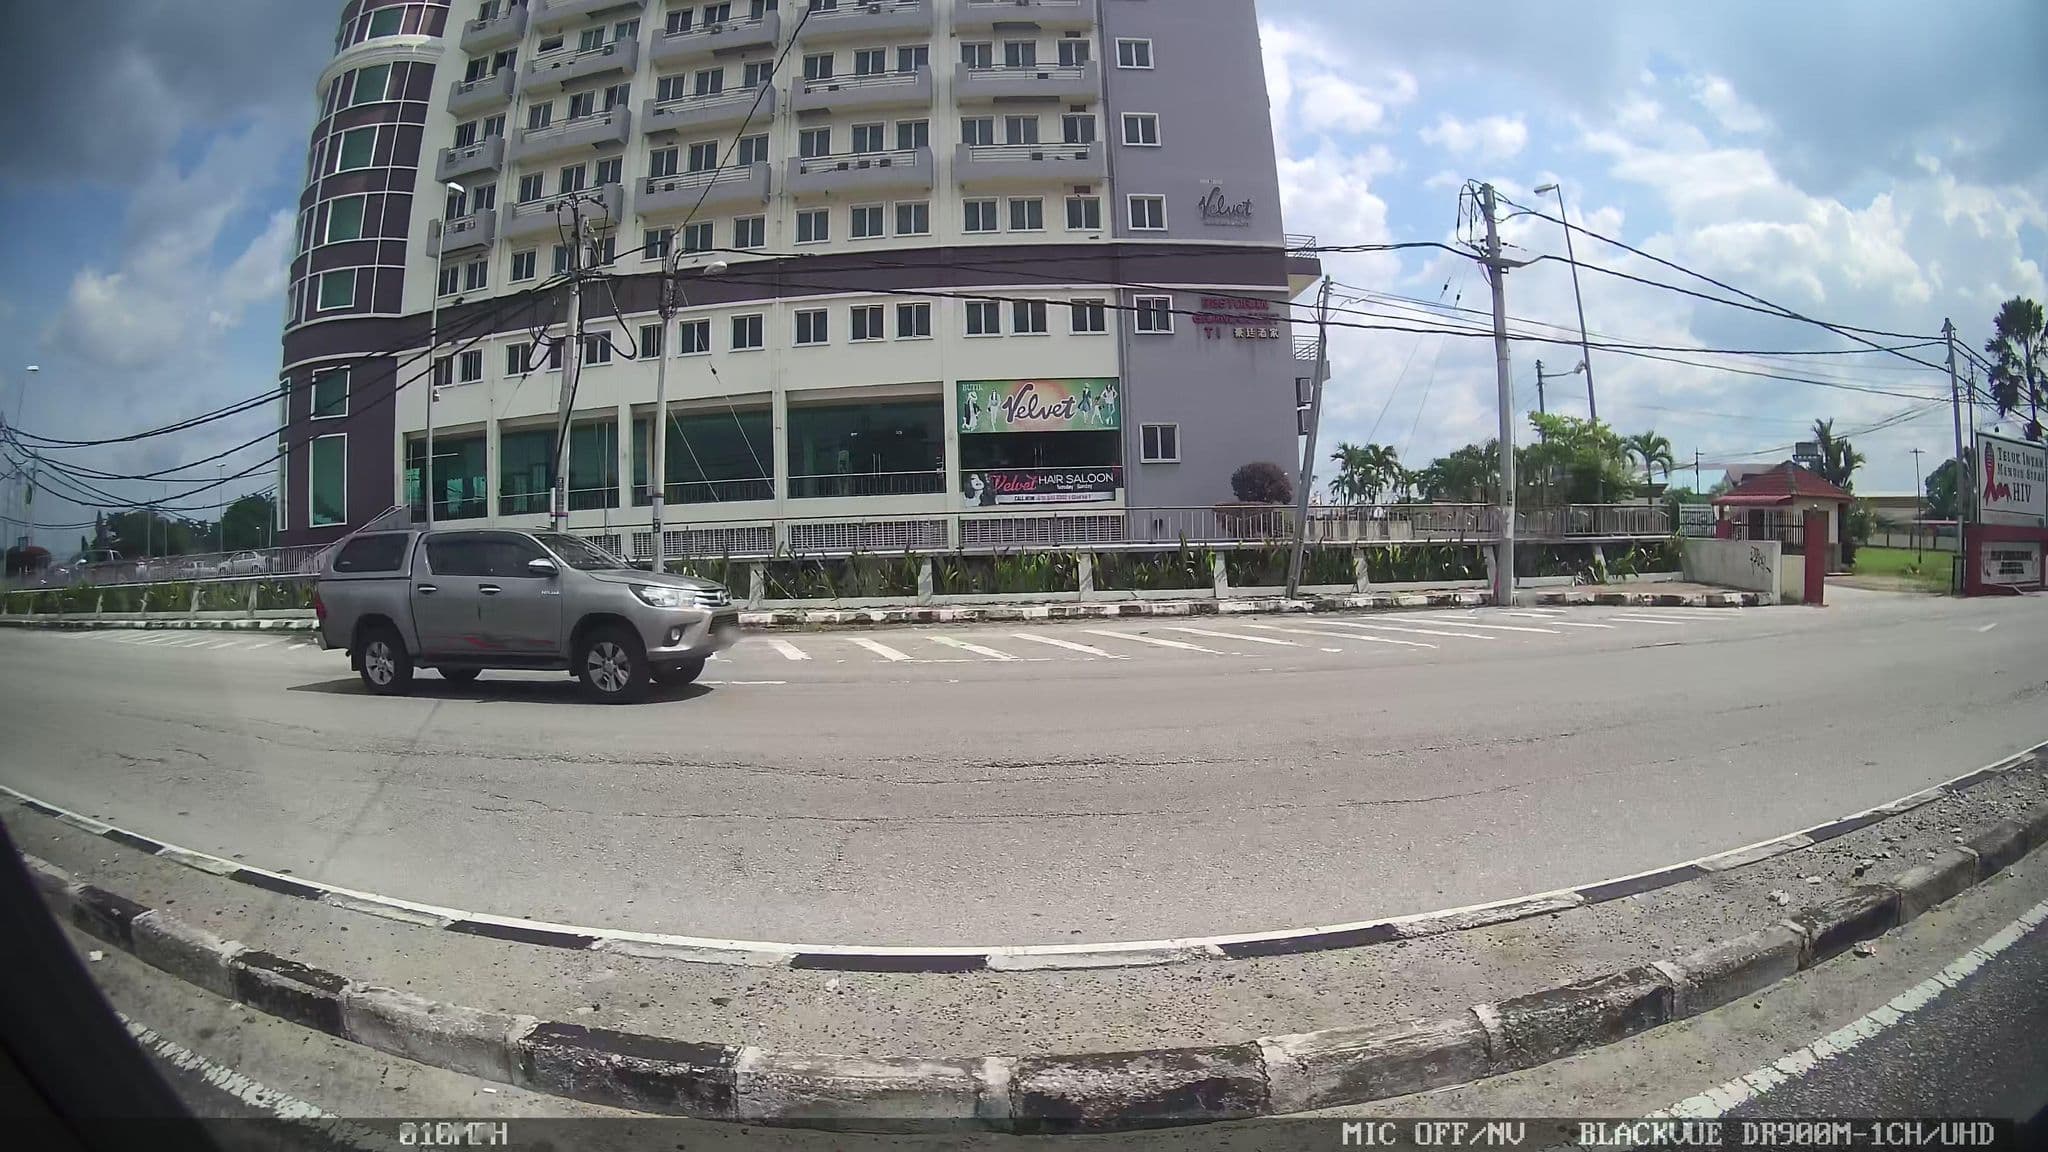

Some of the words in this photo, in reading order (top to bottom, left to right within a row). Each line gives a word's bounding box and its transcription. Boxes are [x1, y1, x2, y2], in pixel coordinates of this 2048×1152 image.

[1198, 186, 1252, 220] Velvet
[1002, 383, 1075, 423] Velvet
[992, 474, 1036, 492] Velvet
[1038, 474, 1063, 485] HAIR
[1066, 472, 1114, 484] SALOON
[2012, 482, 2032, 503] HIV
